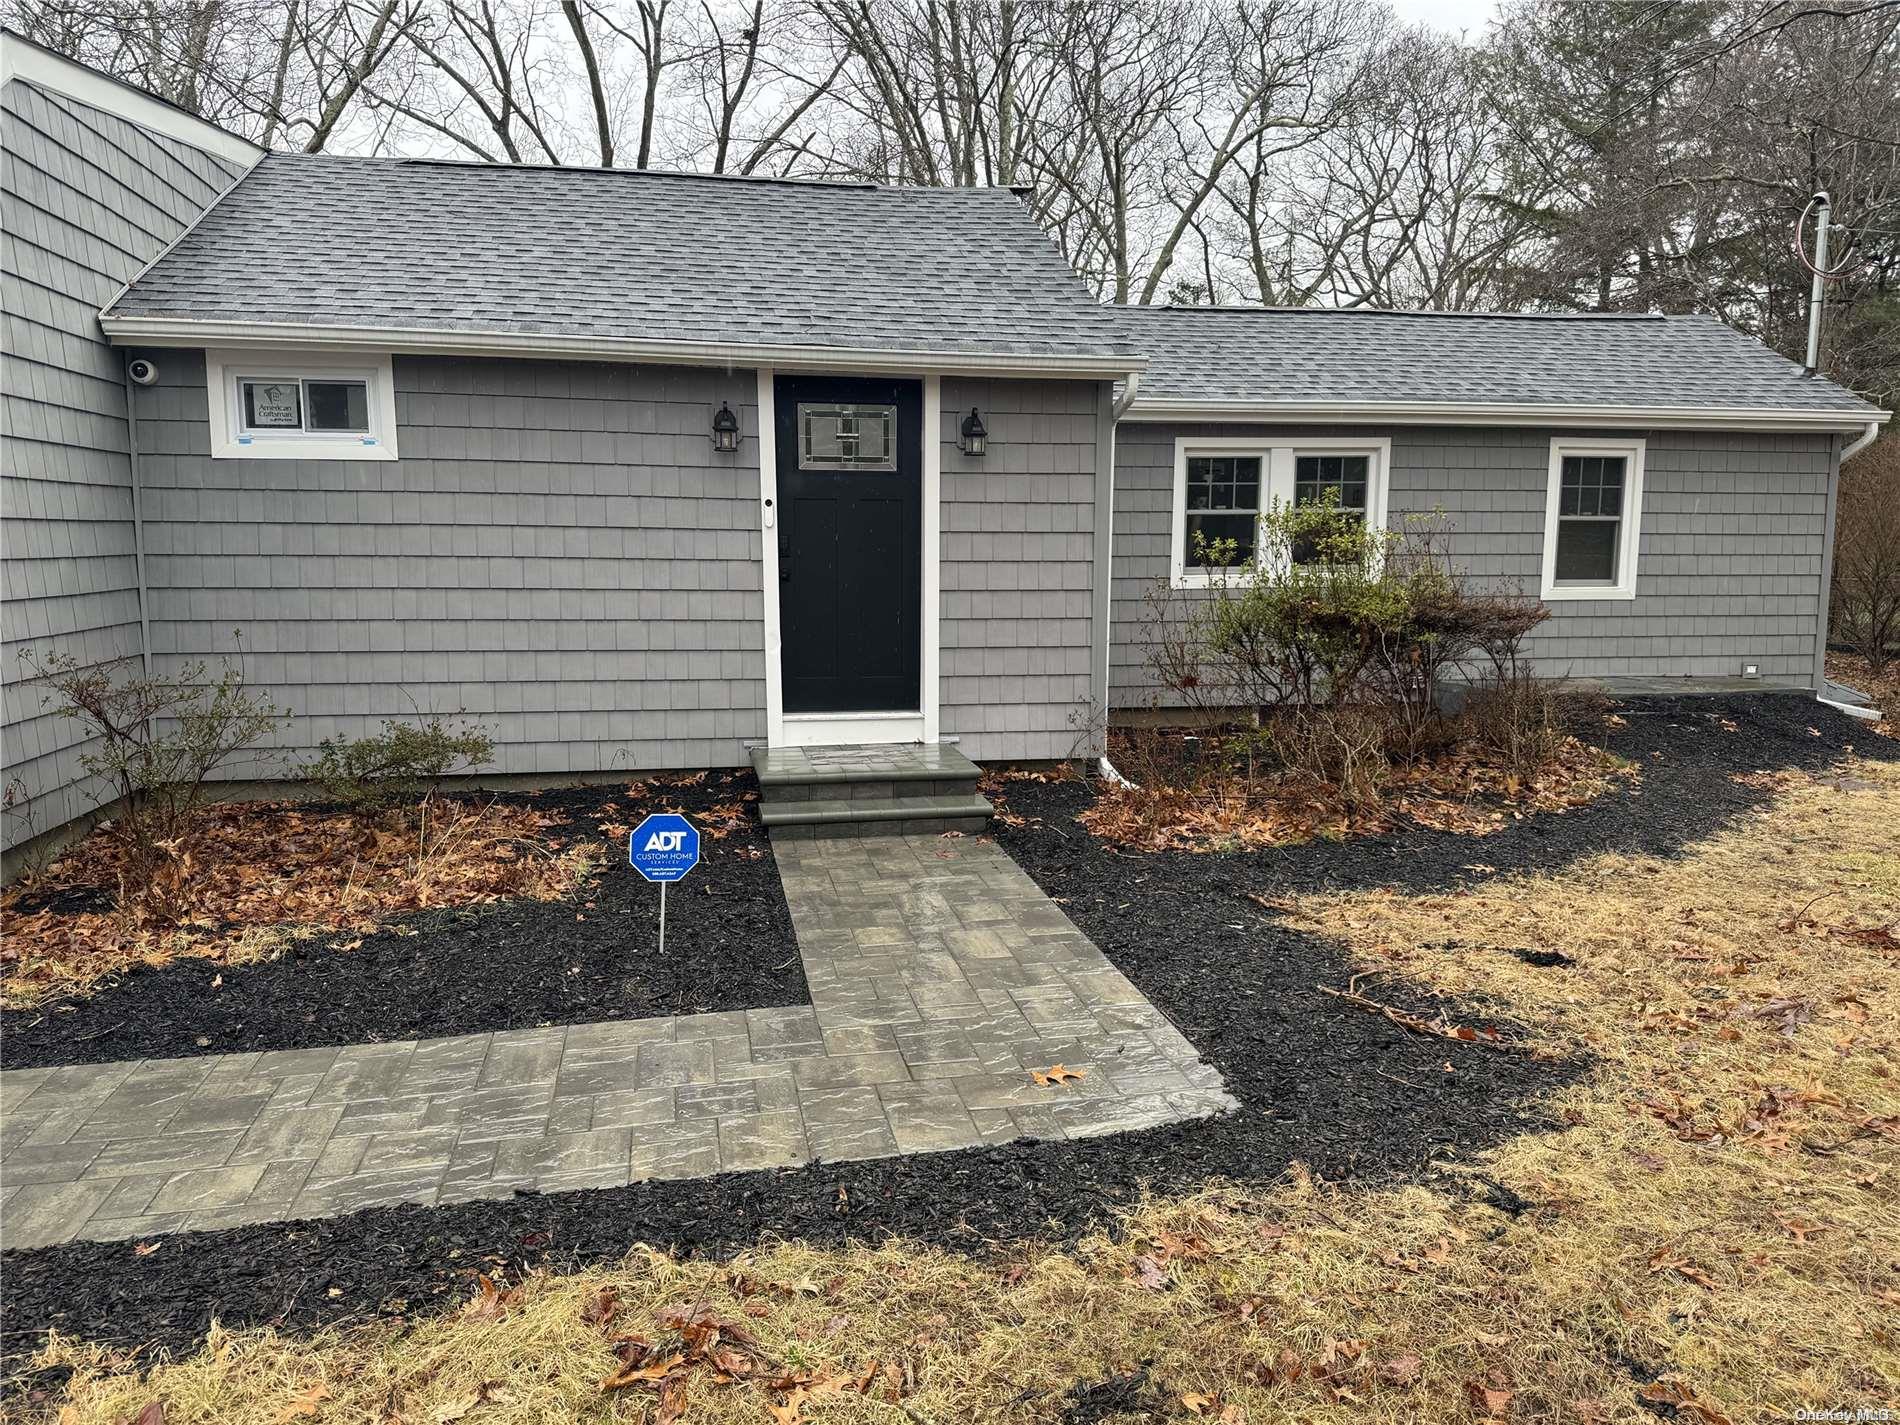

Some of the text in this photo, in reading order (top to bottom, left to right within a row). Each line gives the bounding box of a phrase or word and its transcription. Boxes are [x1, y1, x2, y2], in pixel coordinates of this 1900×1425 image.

[644, 831, 687, 851] ADT
[636, 852, 693, 861] CUSTOM HOME
